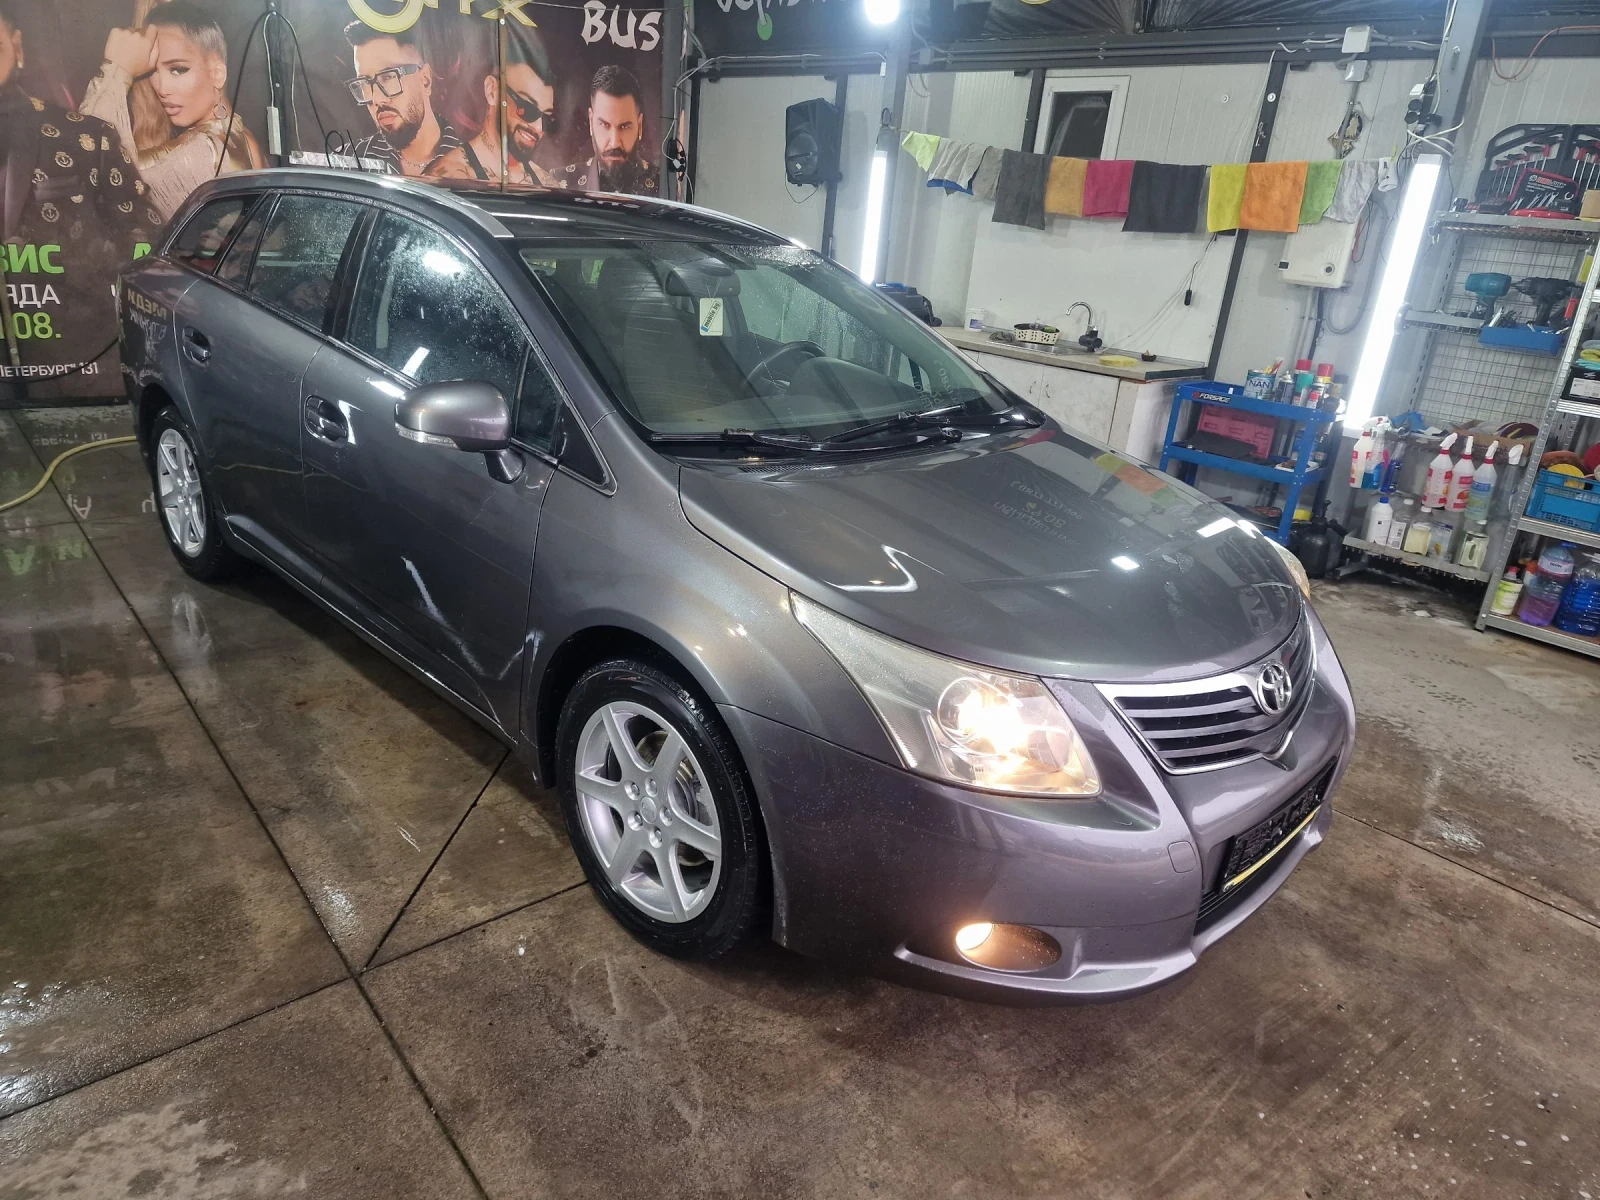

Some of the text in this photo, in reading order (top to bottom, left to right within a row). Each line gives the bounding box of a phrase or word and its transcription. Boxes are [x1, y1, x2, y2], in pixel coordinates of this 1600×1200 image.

[580, 0, 662, 51] BUS
[79, 361, 98, 375] 131
[1249, 380, 1271, 389] NAN
